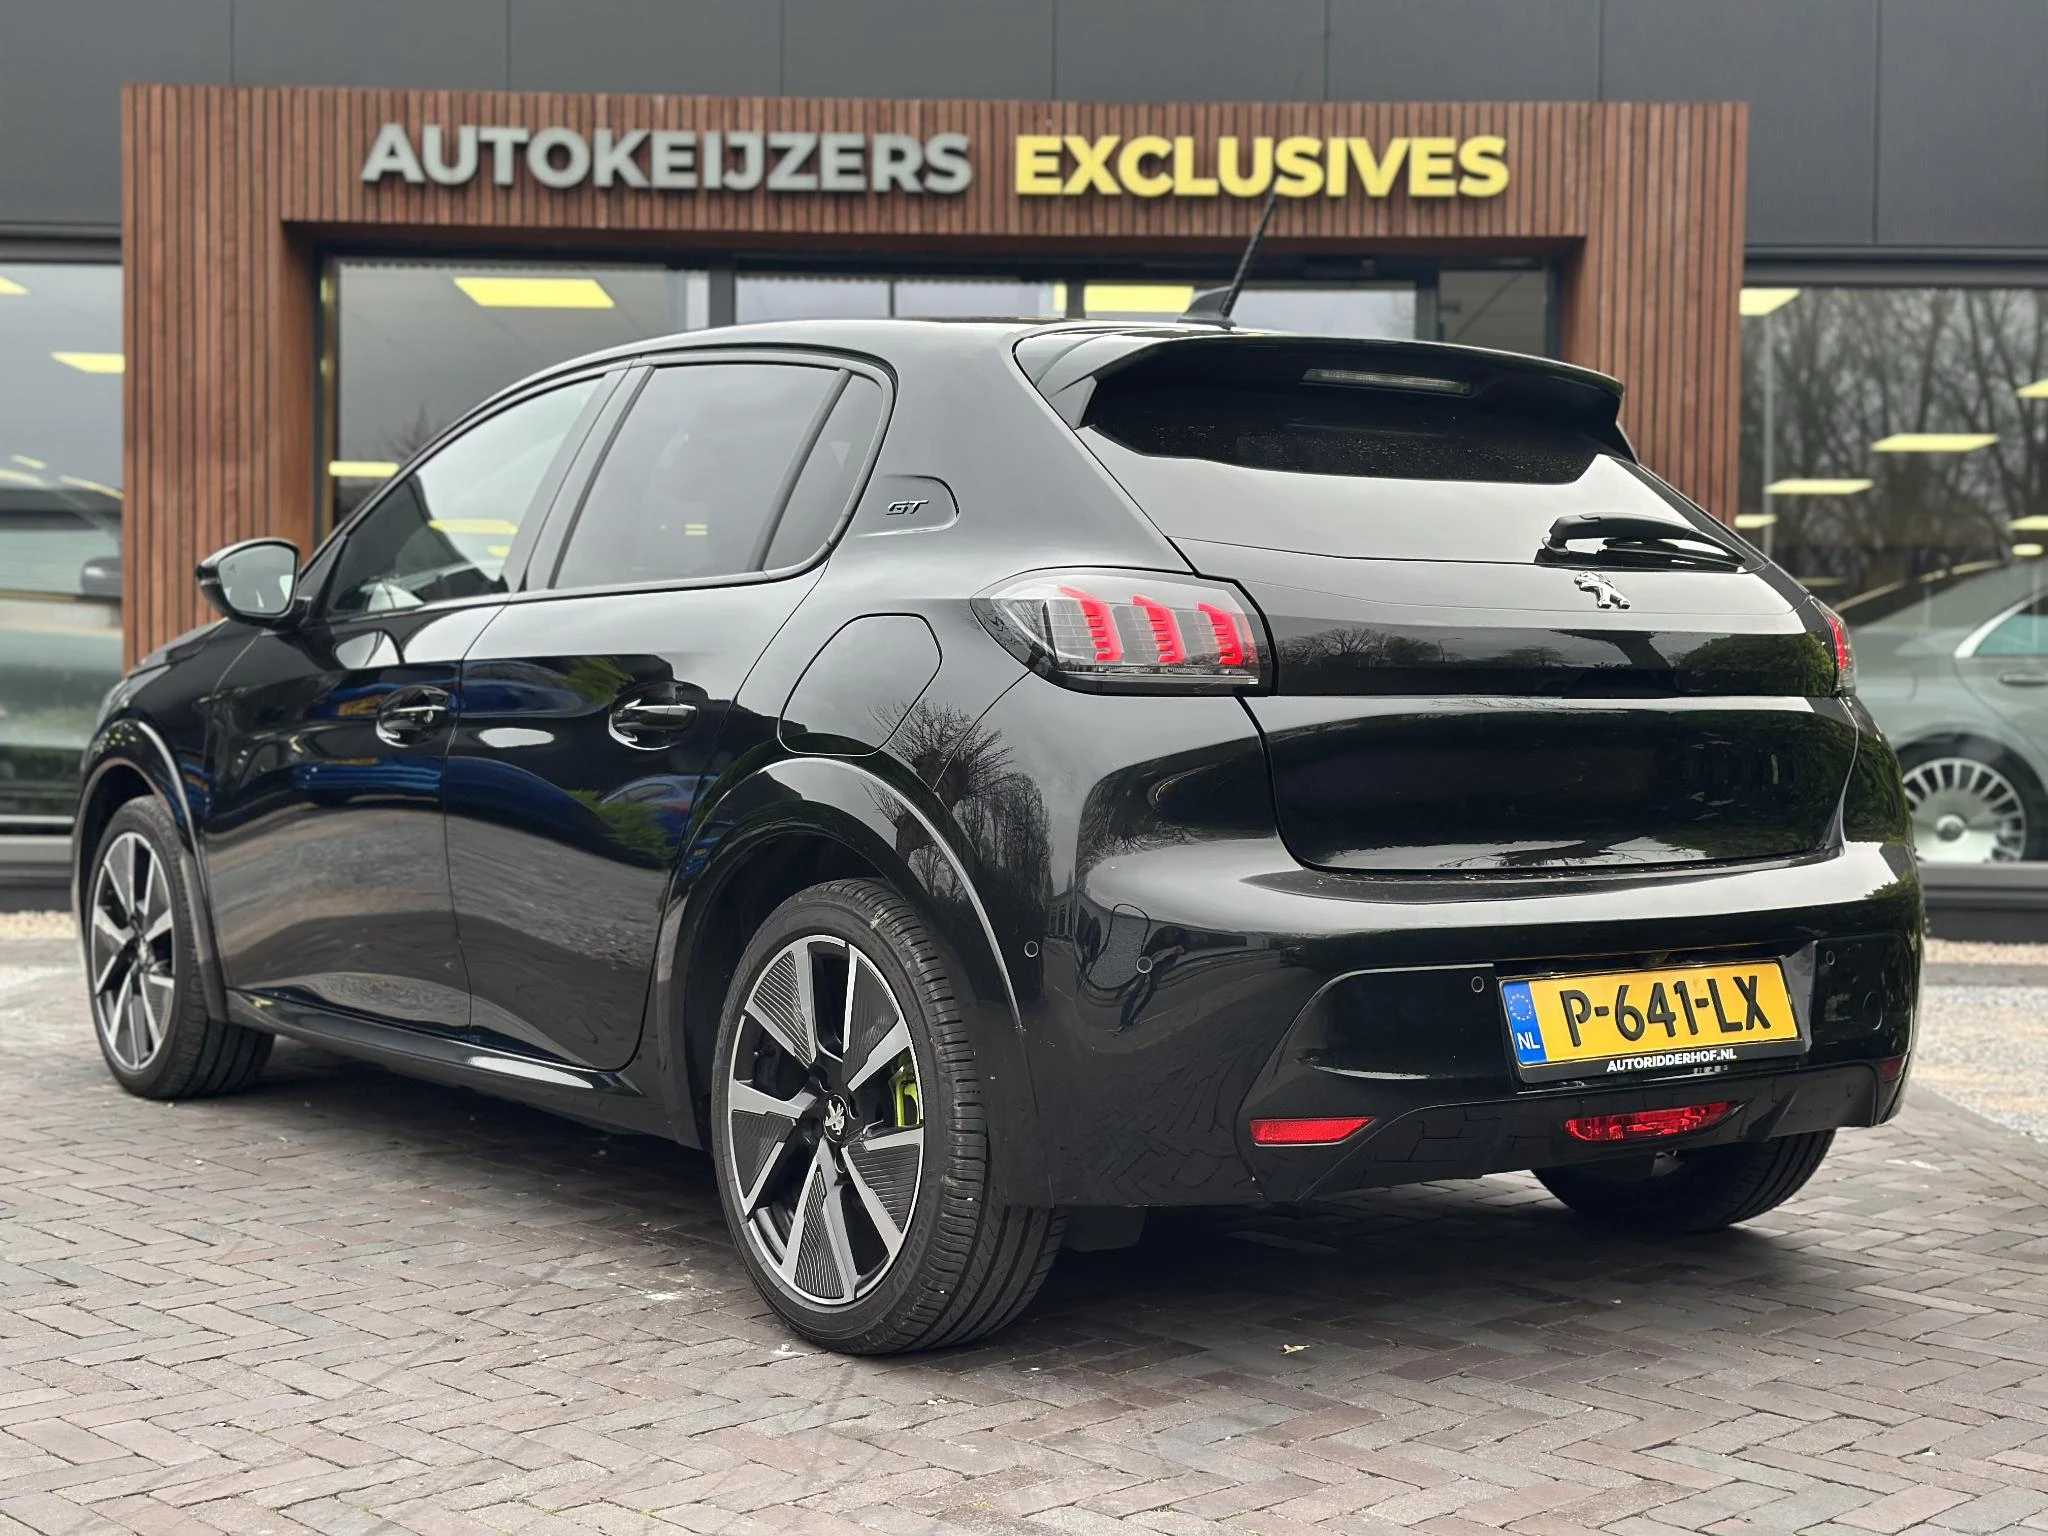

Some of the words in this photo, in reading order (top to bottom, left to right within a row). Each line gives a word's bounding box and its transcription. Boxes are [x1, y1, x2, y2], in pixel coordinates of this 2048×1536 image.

[360, 122, 973, 195] AUTOKEIJZERS
[1015, 134, 1510, 198] EXCLUSIVES
[886, 500, 929, 515] GT
[1560, 975, 1771, 1047] P-641-LX
[1517, 1032, 1540, 1050] NL
[1606, 1048, 1737, 1072] AUTORIDDERHOF.NL
